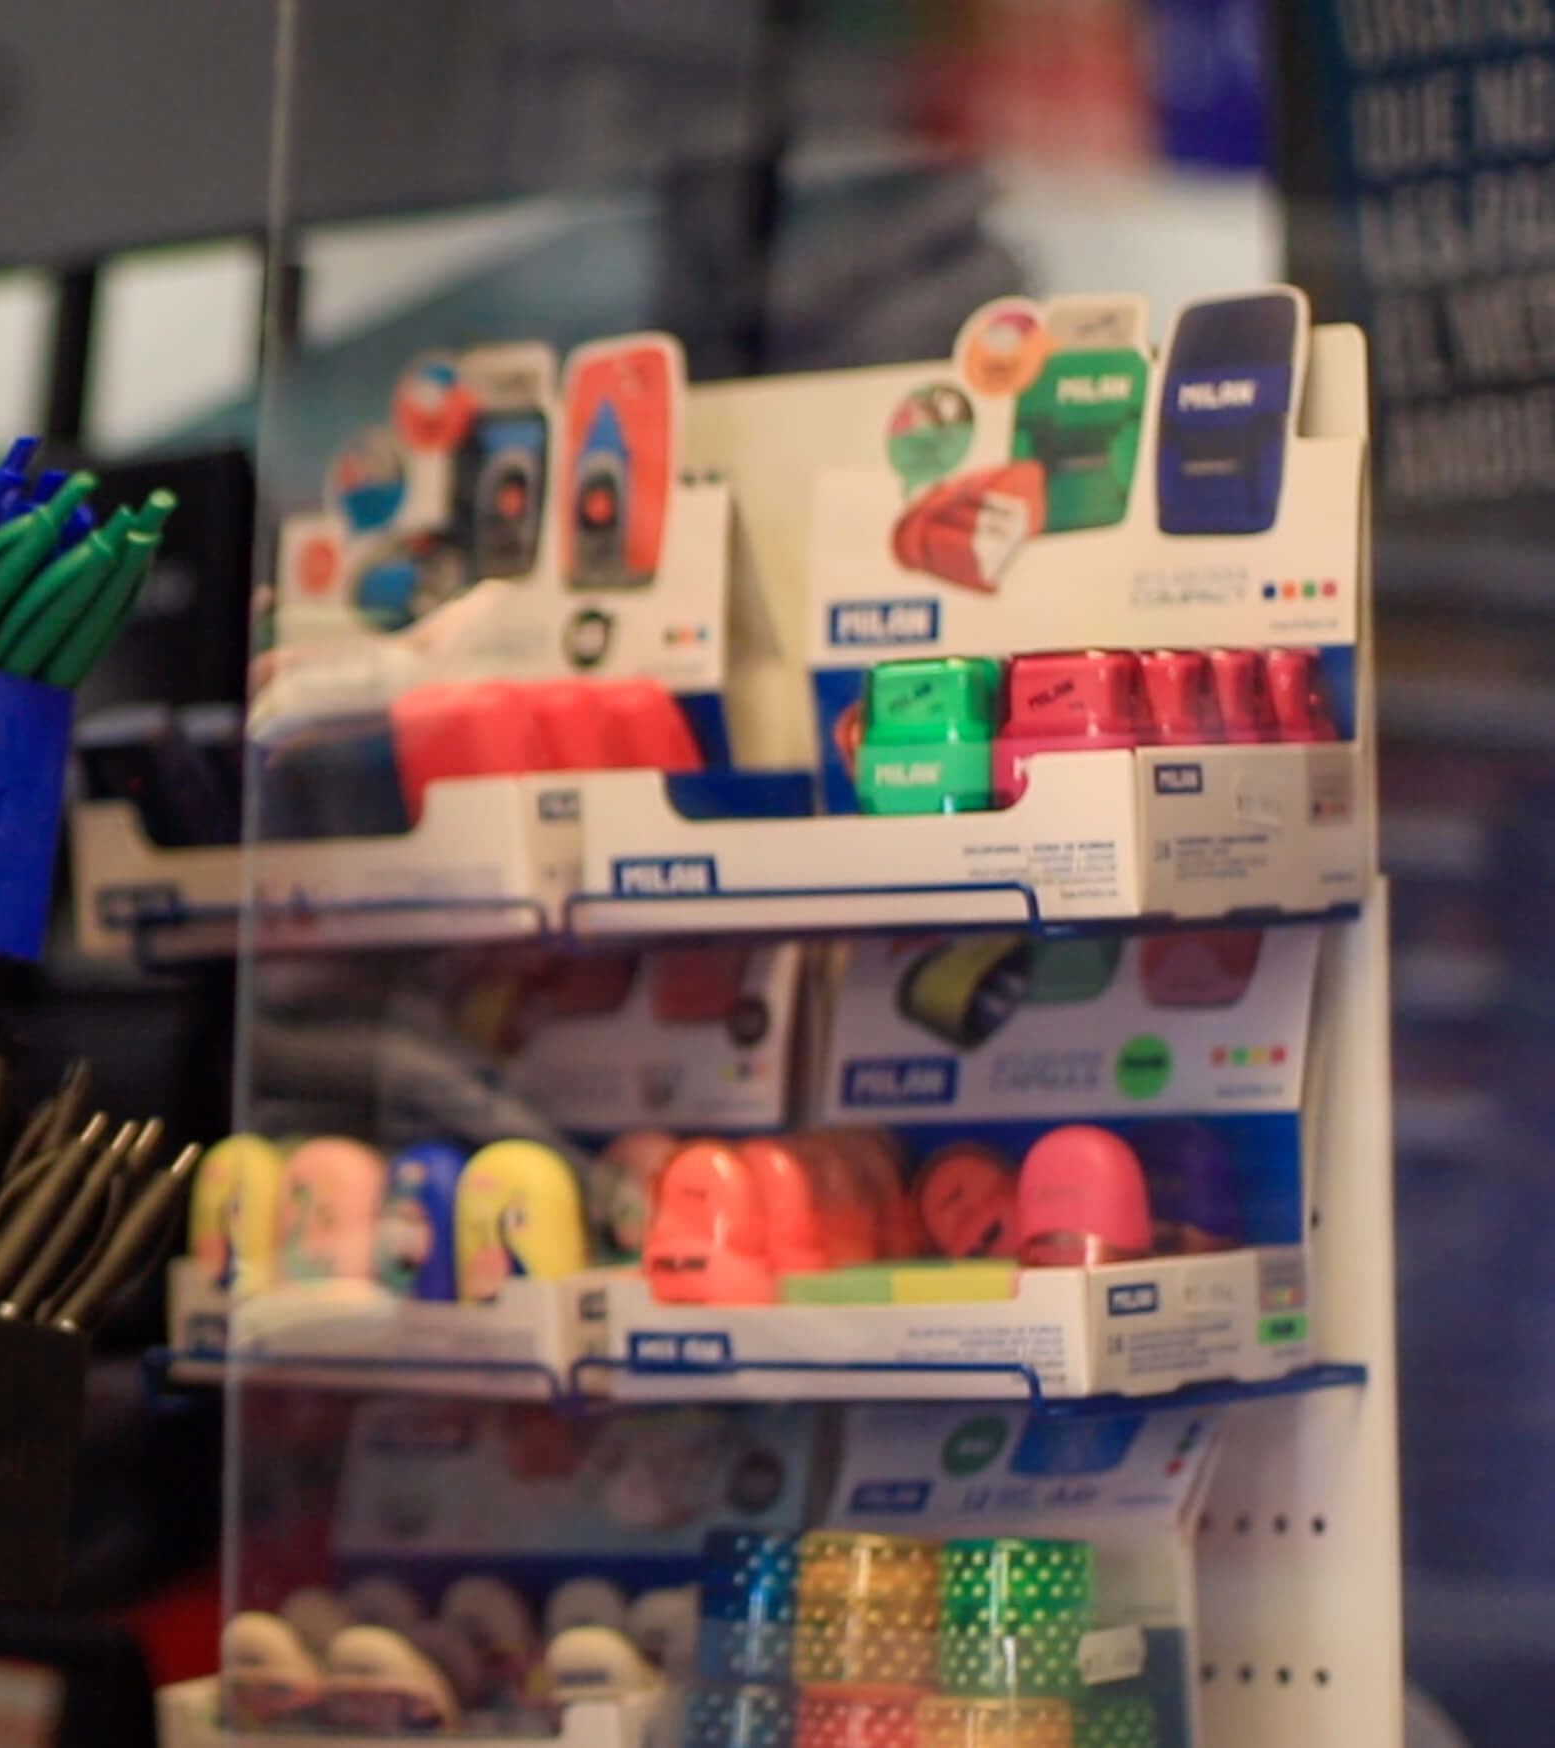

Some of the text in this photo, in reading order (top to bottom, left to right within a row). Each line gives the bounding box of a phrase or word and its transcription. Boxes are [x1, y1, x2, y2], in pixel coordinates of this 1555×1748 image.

[1056, 375, 1133, 404] MILAN
[1177, 379, 1257, 411] MILAN
[835, 605, 932, 642] MILAN
[874, 760, 942, 787] MILAN
[622, 862, 707, 894] MILAN
[853, 1067, 947, 1100] MILAN
